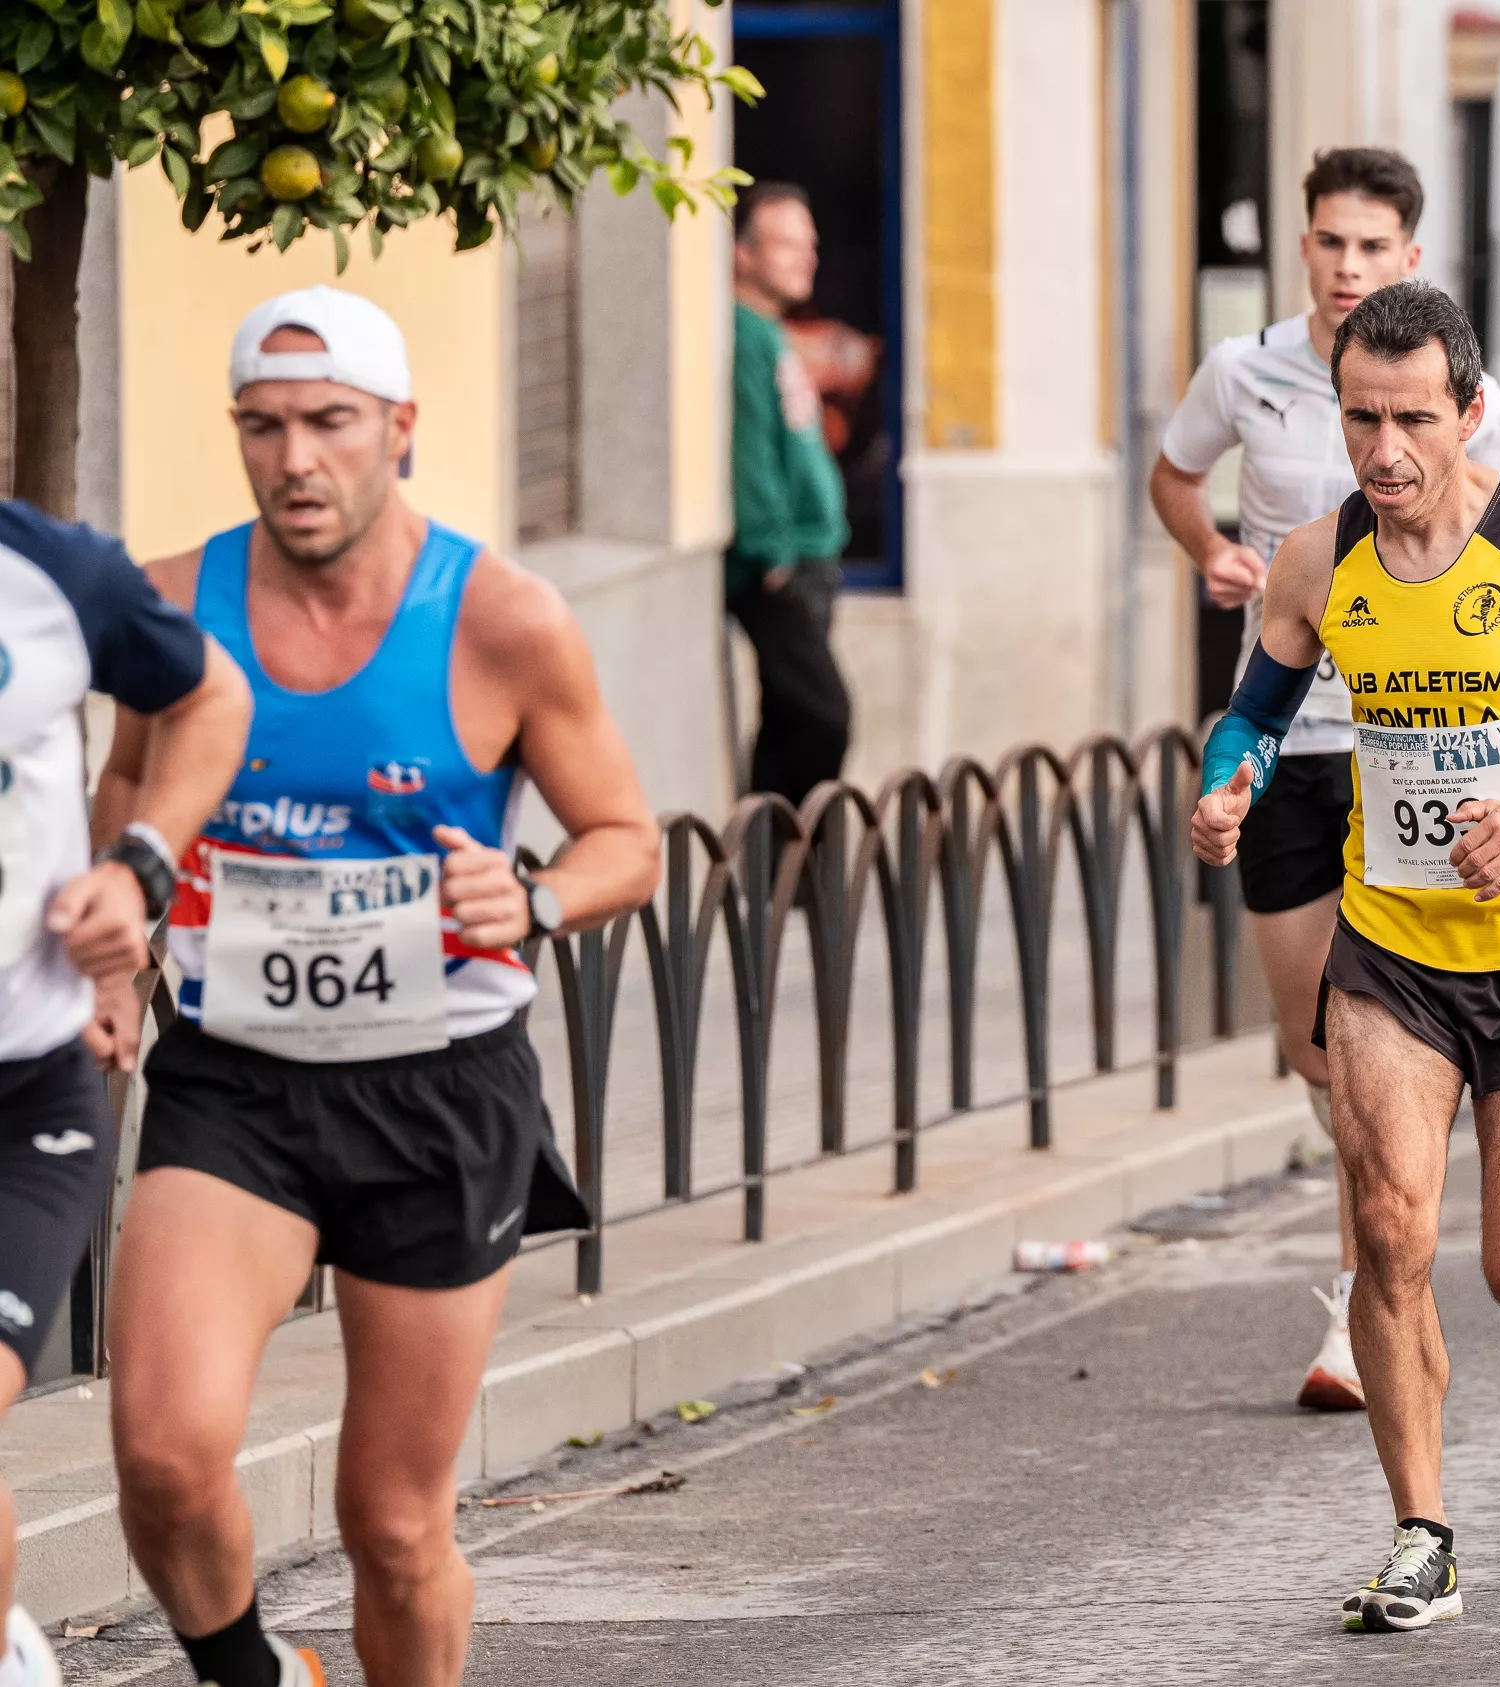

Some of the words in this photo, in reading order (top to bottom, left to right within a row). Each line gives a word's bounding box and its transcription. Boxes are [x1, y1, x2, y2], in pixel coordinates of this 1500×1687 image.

[1342, 617, 1379, 628] austral
[1381, 733, 1417, 742] PROVINCIAL
[1429, 731, 1475, 751] 2024
[1360, 737, 1388, 749] CARRERAS
[1389, 742, 1429, 751] POPULARES
[1398, 858, 1419, 866] RAFAEL
[263, 946, 395, 1008] 964
